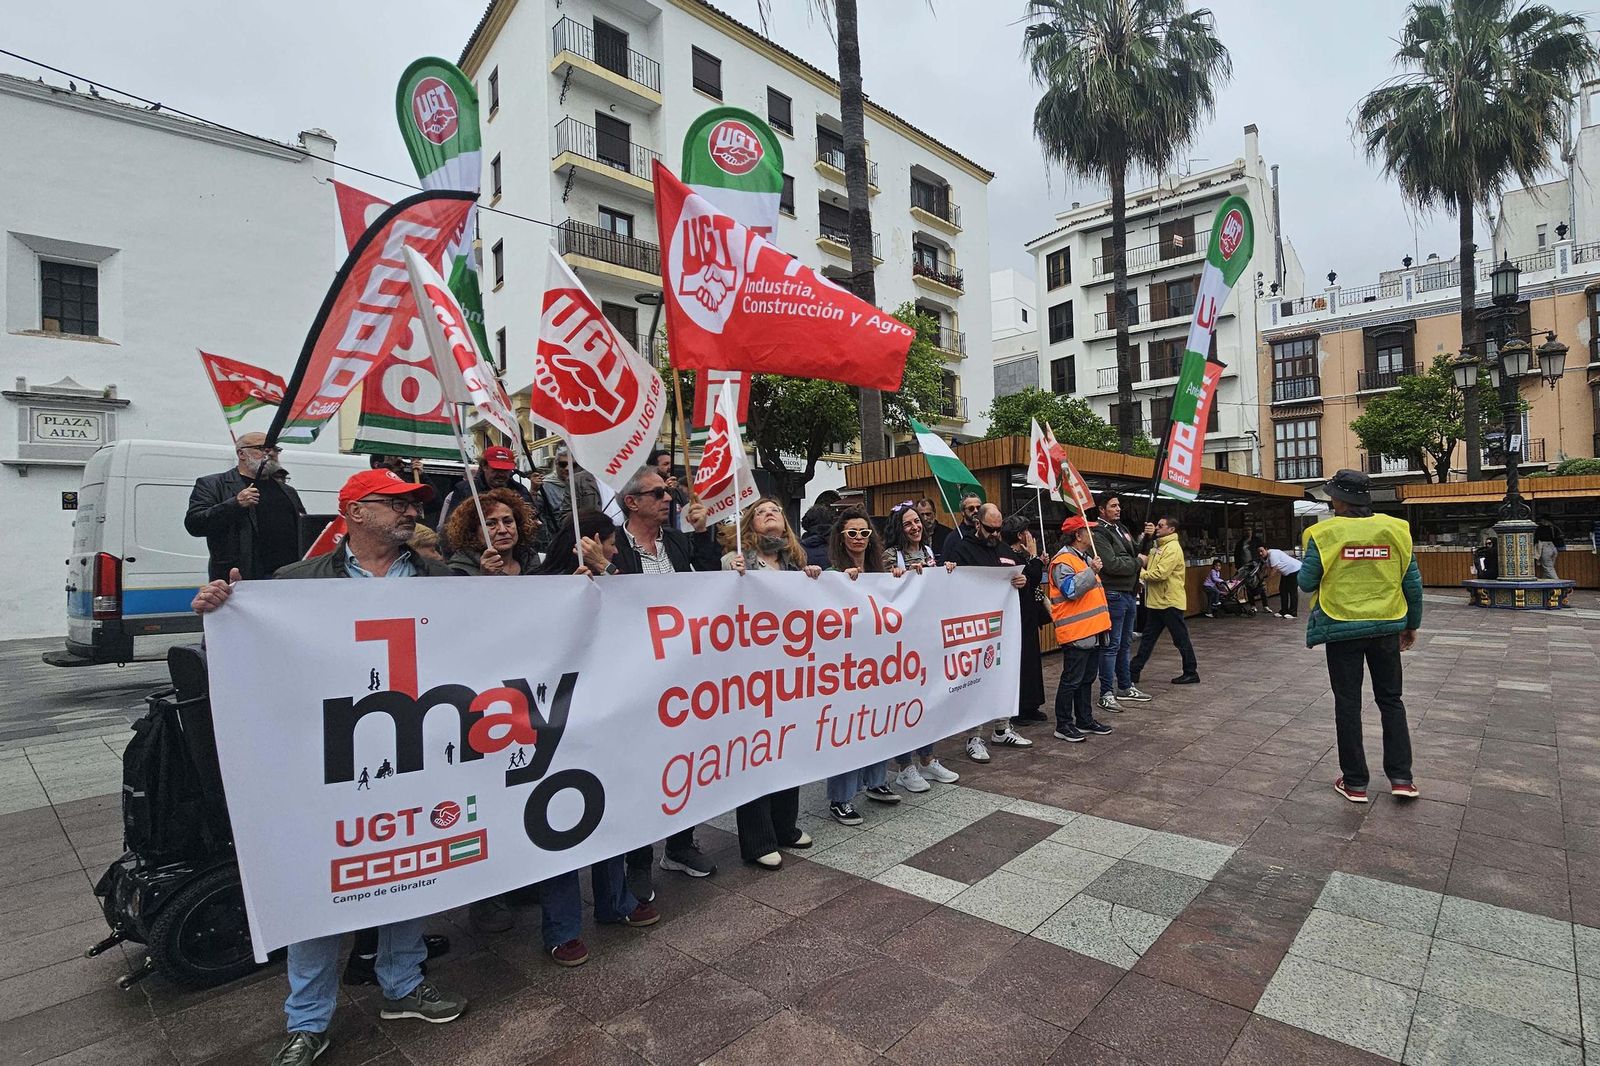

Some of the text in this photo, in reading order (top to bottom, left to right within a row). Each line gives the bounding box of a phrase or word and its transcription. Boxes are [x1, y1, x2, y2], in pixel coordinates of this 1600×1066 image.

[416, 85, 448, 118] UGT
[717, 128, 759, 153] UGT
[1223, 213, 1242, 238] UGT
[682, 214, 736, 275] UGT
[744, 277, 816, 299] Industria,
[742, 295, 913, 338] Construcción y Agro
[541, 294, 628, 396] UGT
[44, 416, 92, 427] PLAZA
[50, 429, 88, 438] ALTA
[1344, 548, 1380, 558] CCOO
[646, 594, 903, 661] Proteger lo
[944, 619, 987, 642] CCOO
[943, 647, 983, 681] UGT
[657, 641, 928, 728] conquistado,
[660, 697, 925, 816] ganar futuro
[335, 806, 424, 848] UGT
[339, 846, 442, 885] CCOO
[332, 877, 438, 904] Campo de Gibraltar
